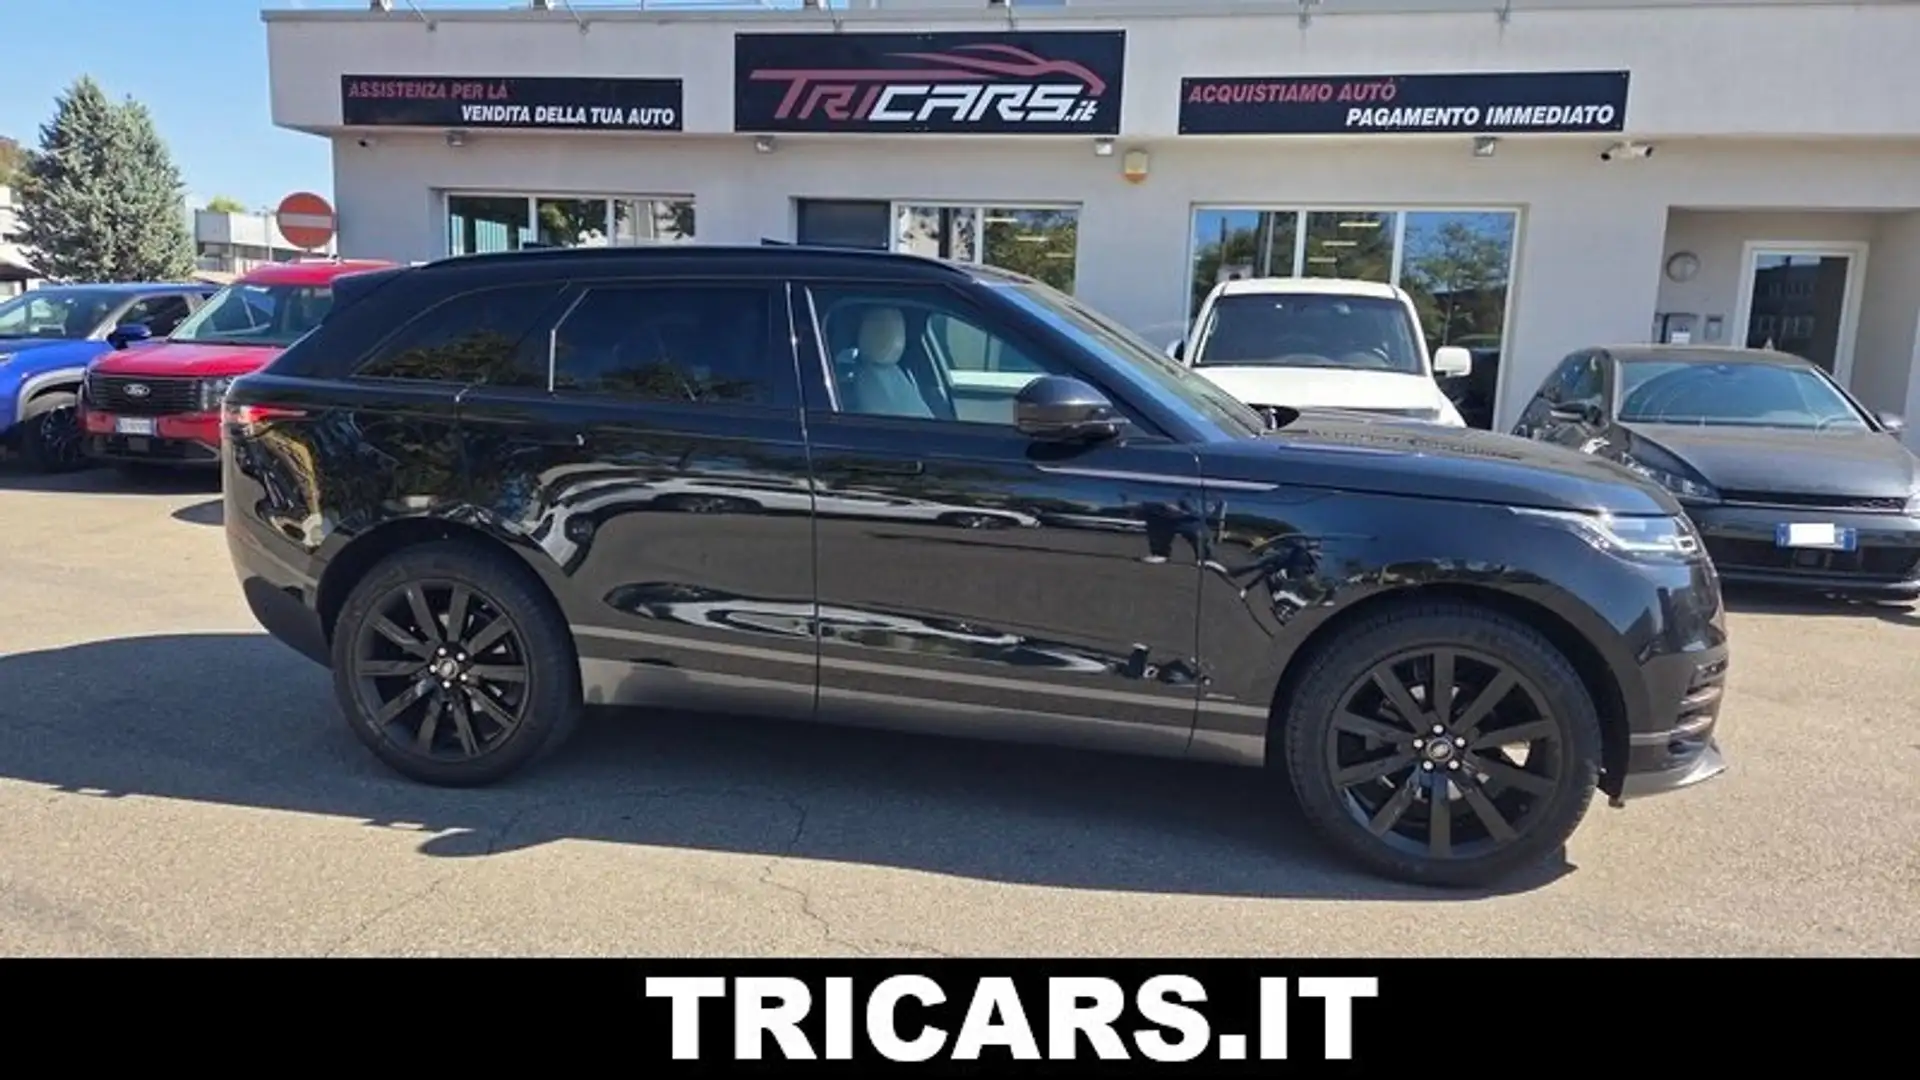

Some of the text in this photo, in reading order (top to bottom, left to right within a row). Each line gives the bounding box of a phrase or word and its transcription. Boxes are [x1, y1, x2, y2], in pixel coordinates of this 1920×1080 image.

[349, 82, 446, 98] ASSISTENZA
[451, 84, 484, 99] PER
[1189, 83, 1332, 103] ACQUISTIAMO
[462, 104, 675, 126] VENDITA DELLA TUA AUTO
[1346, 104, 1615, 127] PAGAMENTO IMMEDIATO
